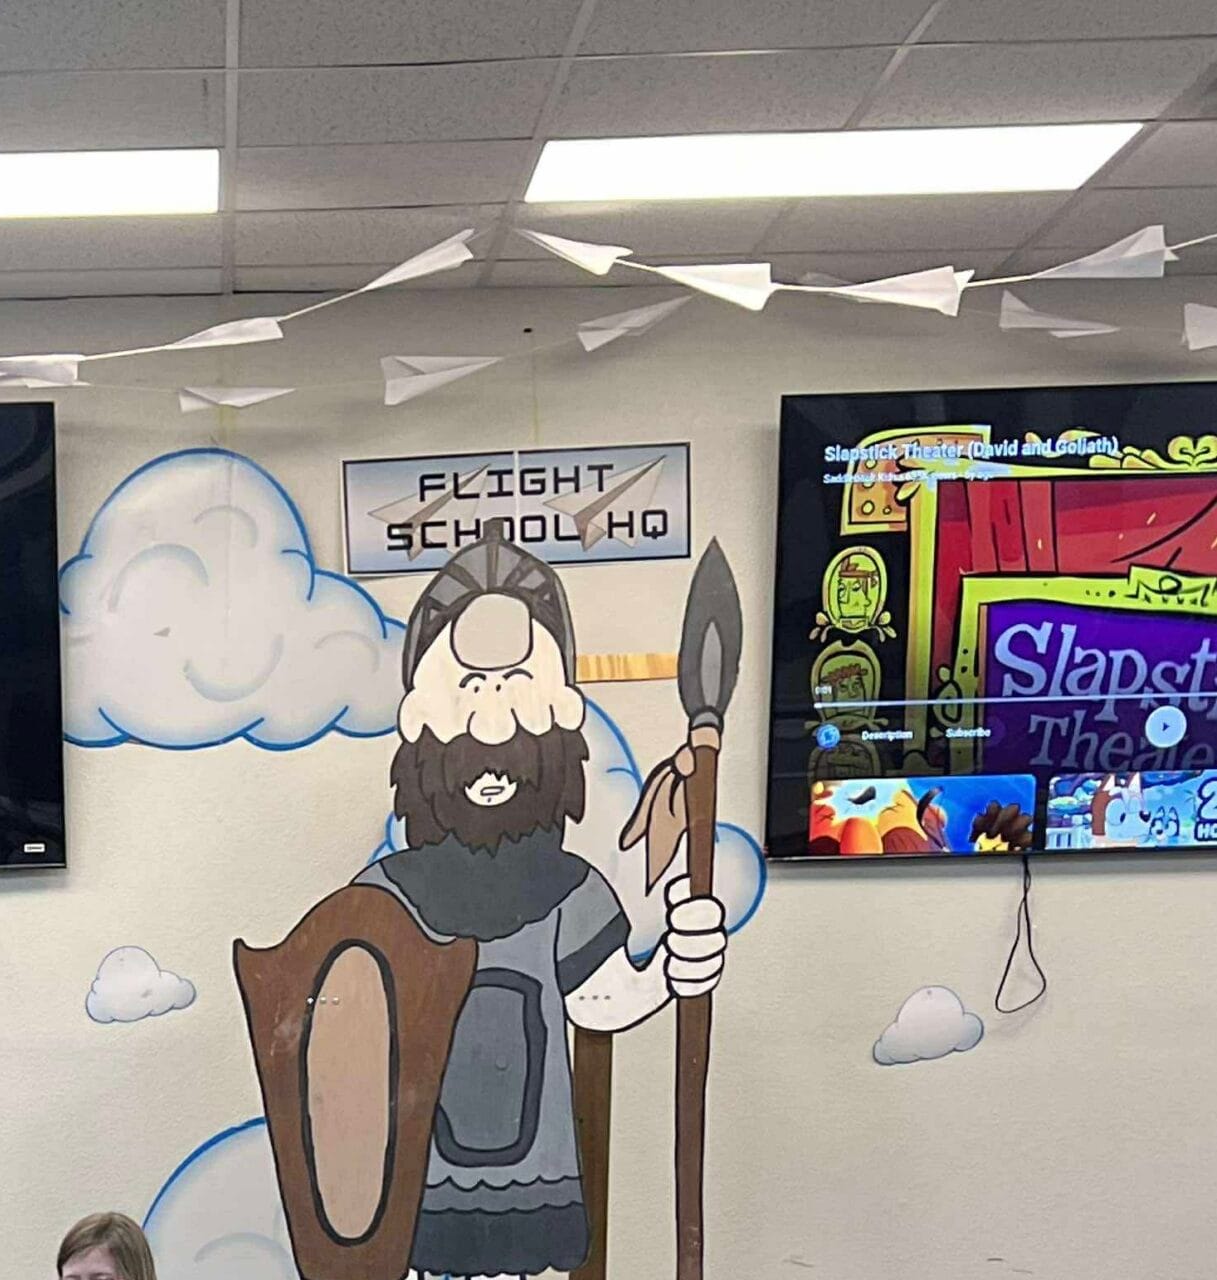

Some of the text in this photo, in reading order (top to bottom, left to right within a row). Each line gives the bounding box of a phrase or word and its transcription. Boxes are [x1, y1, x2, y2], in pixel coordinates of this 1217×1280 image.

[824, 435, 1119, 465] Slapstick Theater (David and Goliath)
[418, 463, 614, 502] FLIGHT
[607, 508, 669, 540] HQ
[994, 621, 1217, 722] Slapst
[861, 727, 992, 742] Description Subscribe
